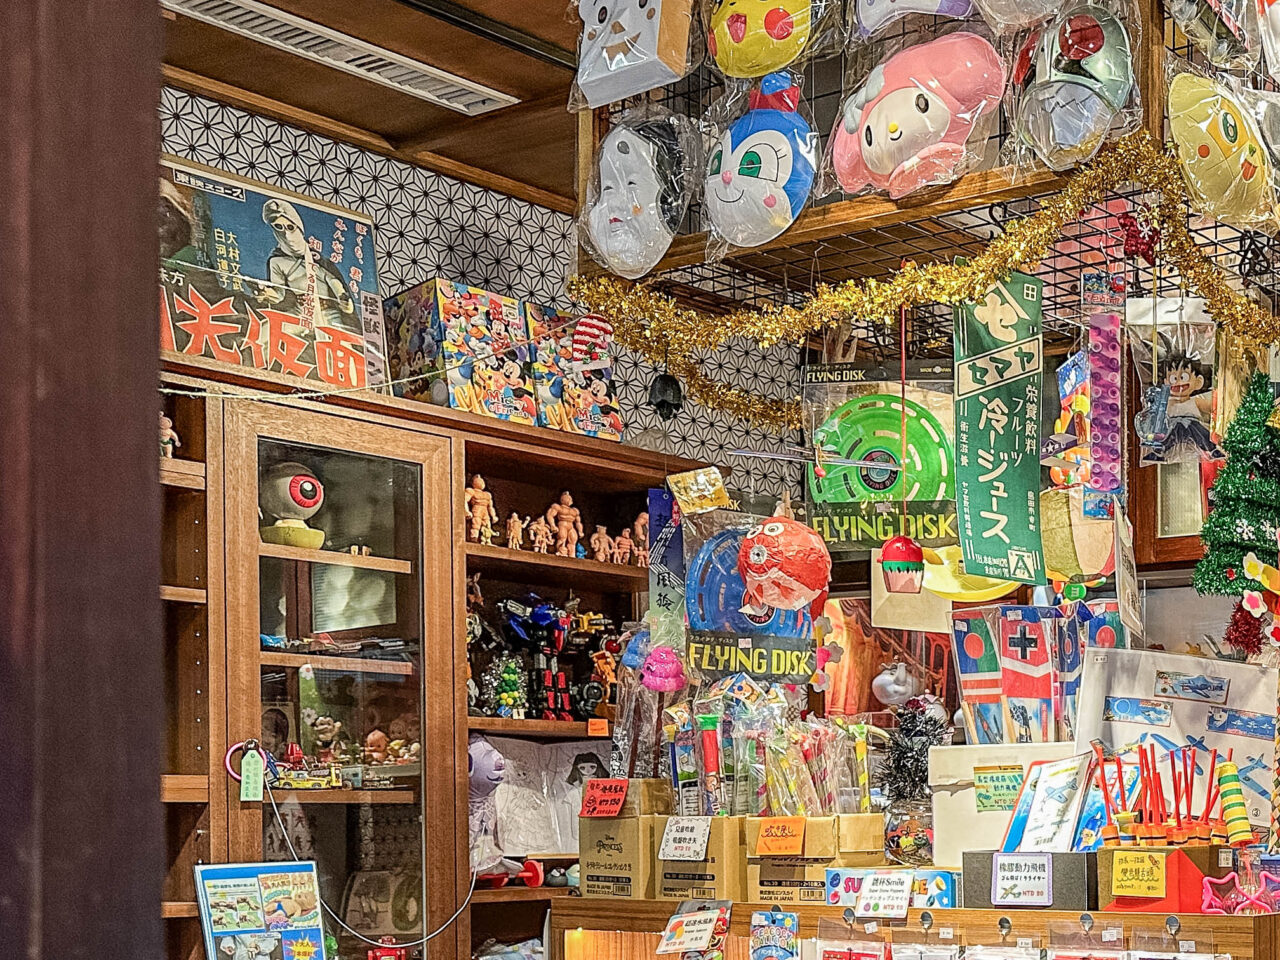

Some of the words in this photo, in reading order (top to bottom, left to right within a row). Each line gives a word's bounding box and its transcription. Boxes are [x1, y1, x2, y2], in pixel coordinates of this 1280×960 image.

[806, 370, 842, 382] FLYING
[842, 369, 866, 381] DISK
[1011, 397, 1024, 468] フルーツ
[812, 514, 894, 543] FLYING
[899, 512, 958, 540] DISK
[688, 642, 767, 674] FLYING
[770, 649, 814, 676] DISK
